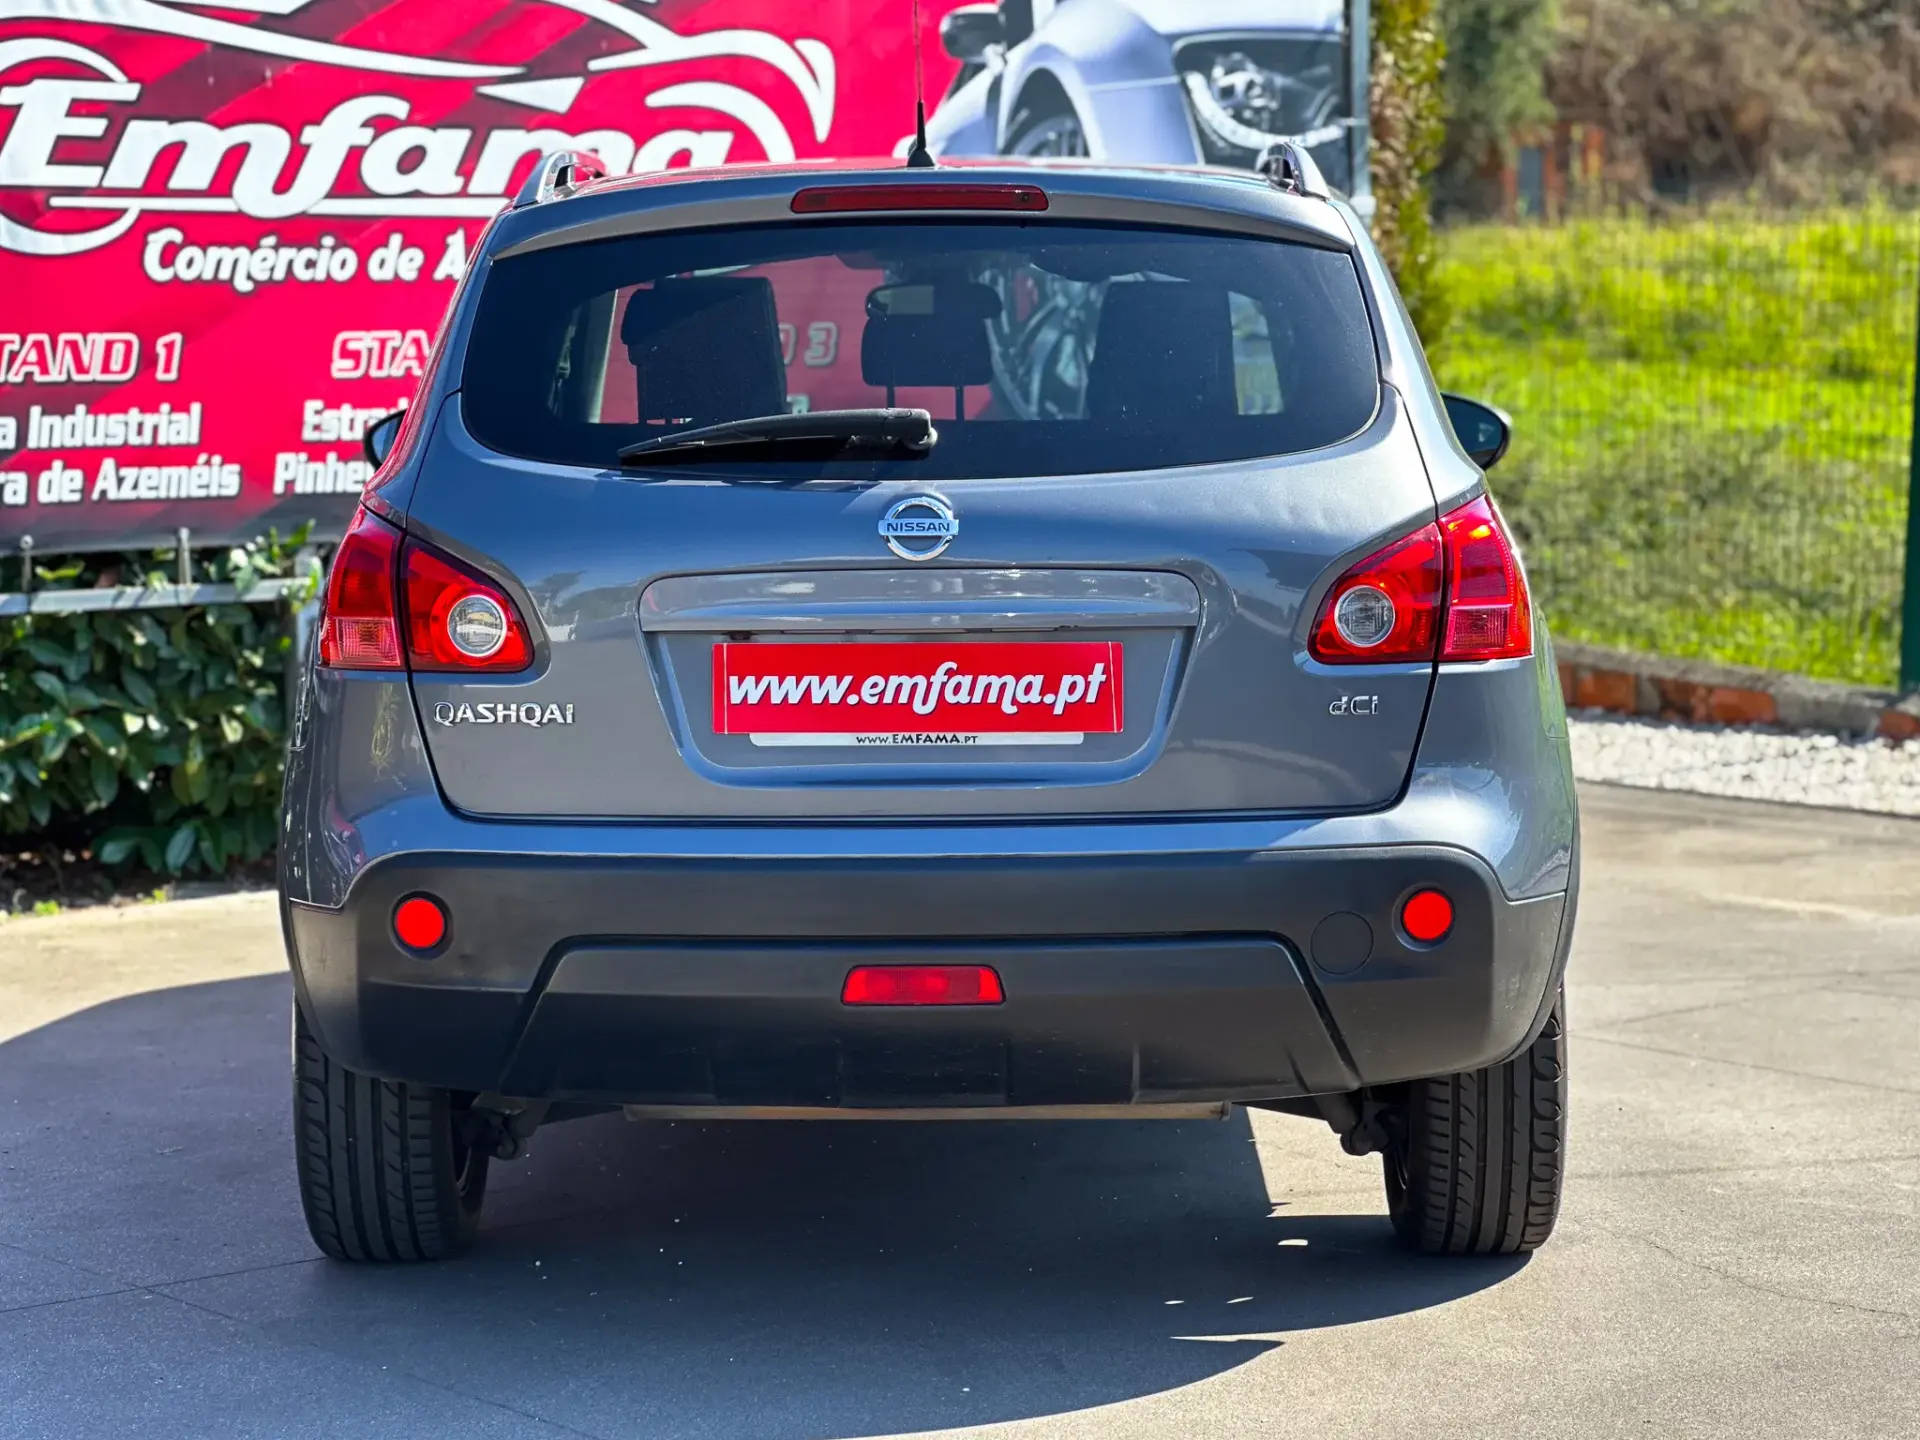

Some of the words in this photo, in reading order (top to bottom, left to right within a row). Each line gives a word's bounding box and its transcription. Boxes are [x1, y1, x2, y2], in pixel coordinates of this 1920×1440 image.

[0, 79, 735, 219] Emfama
[143, 227, 359, 293] Comércio
[367, 231, 425, 282] de
[155, 332, 183, 382] 1
[27, 402, 202, 449] Industrial
[37, 459, 84, 503] de
[91, 453, 241, 501] Azeméis
[886, 522, 950, 532] NISSAN
[728, 661, 1107, 716] www.emfama.pt
